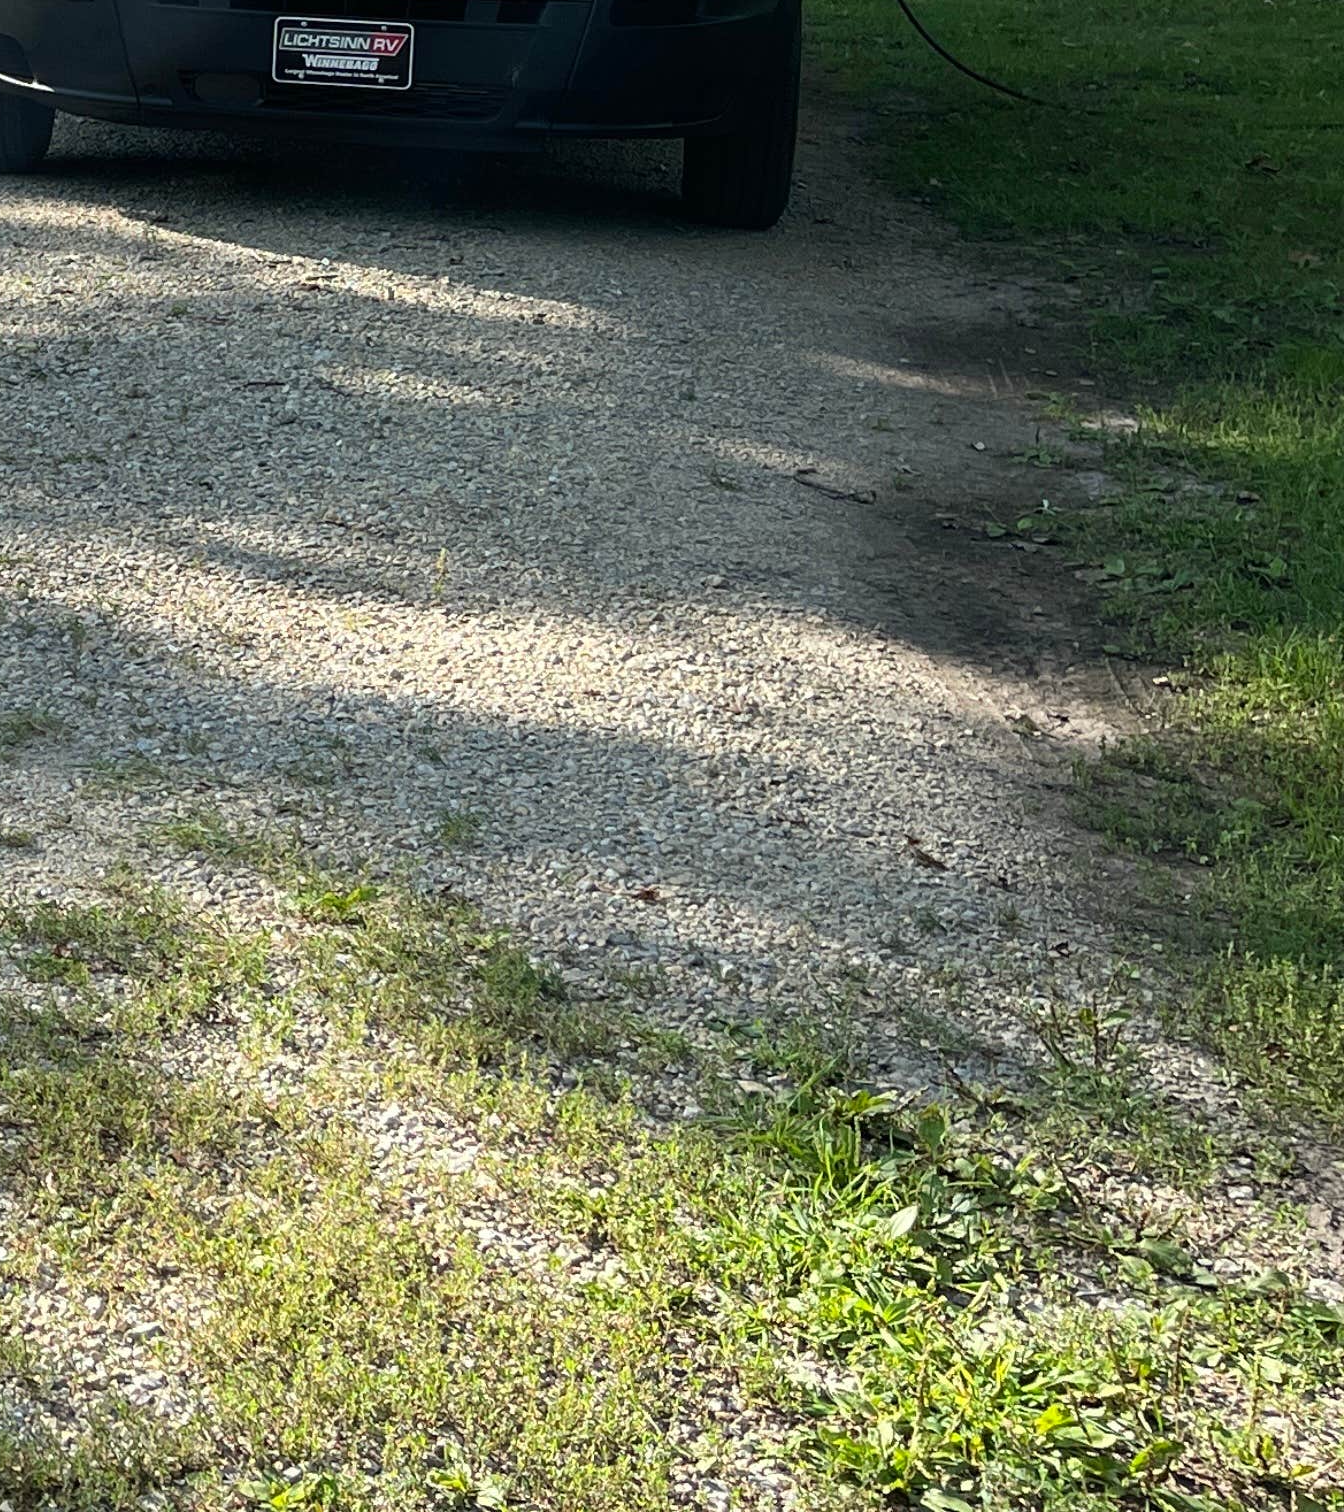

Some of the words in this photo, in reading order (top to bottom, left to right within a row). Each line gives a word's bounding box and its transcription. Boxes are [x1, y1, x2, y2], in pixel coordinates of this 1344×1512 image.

[284, 33, 371, 50] LICHTSINN
[372, 38, 400, 51] RV
[302, 54, 380, 71] WINNEBAGO
